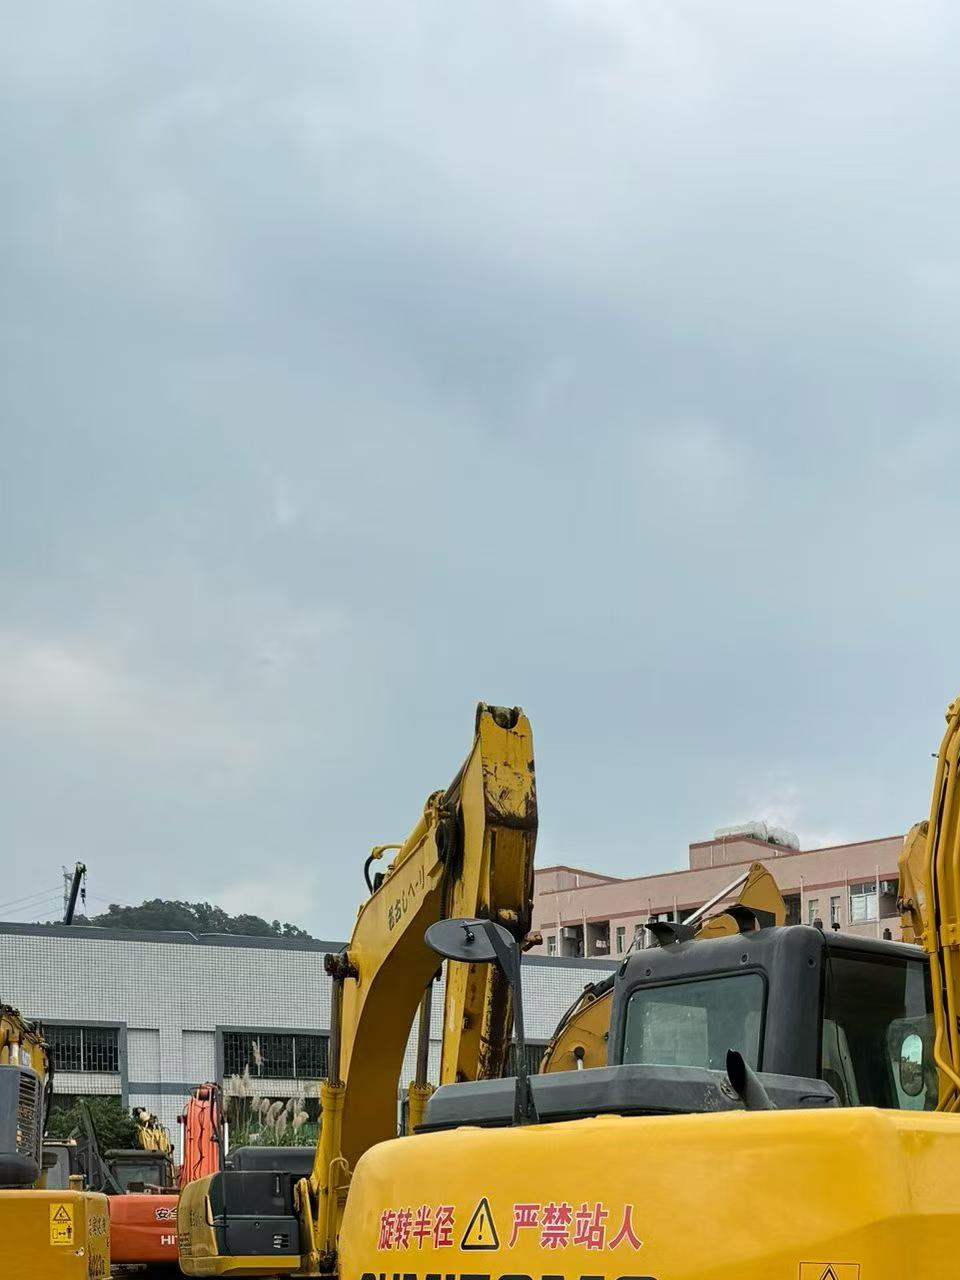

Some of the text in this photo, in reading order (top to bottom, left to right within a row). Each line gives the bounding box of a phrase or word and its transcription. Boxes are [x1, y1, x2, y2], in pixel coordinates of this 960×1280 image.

[377, 1202, 642, 1250] 旋转半径 严禁站人
